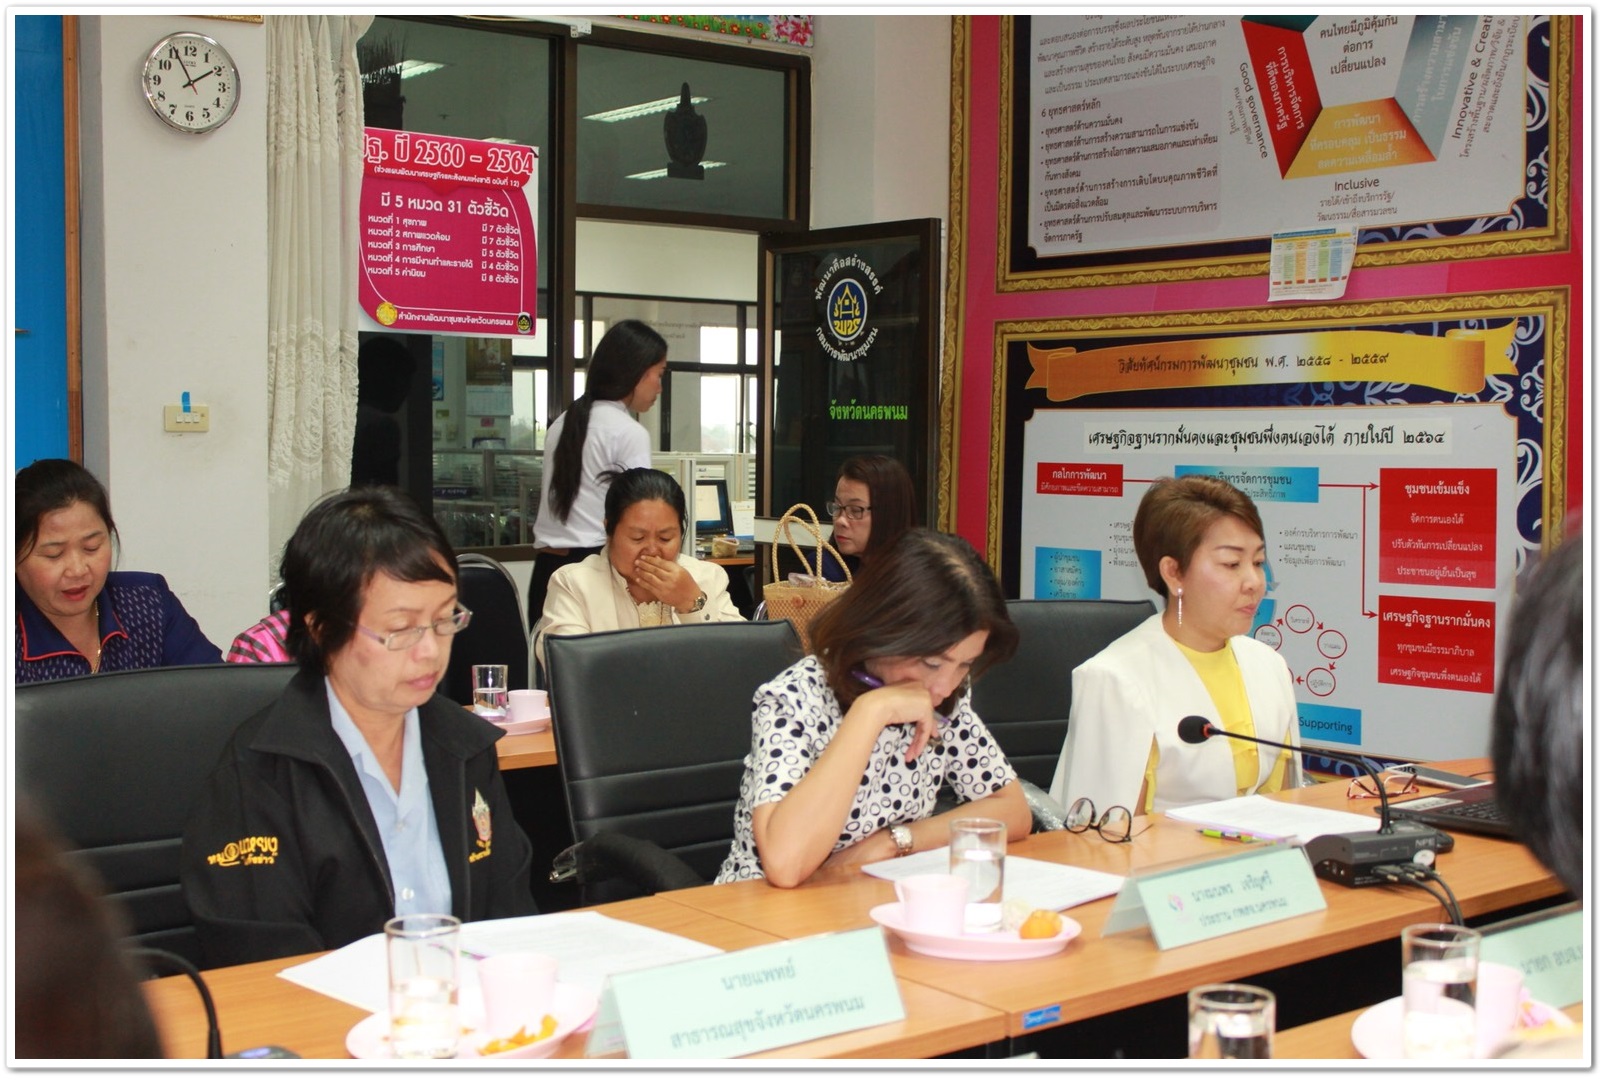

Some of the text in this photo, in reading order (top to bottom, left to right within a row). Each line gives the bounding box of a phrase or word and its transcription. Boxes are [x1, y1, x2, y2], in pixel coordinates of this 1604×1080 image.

[1320, 15, 1398, 39] คนไทยมีภูมิคุ้มกัน
[169, 46, 179, 59] 11
[184, 46, 197, 57] 12
[1343, 39, 1373, 54] ต่อการ
[204, 52, 209, 63] 1
[159, 59, 172, 71] 10
[214, 66, 222, 76] 2
[1330, 56, 1386, 75] เปลี่ยนแปลง
[153, 75, 161, 85] 9
[218, 82, 227, 93] 3
[1278, 46, 1305, 130] การบริหารจัดการ
[158, 91, 166, 101] 8
[213, 97, 220, 108] 4
[1266, 61, 1290, 131] ที่ดีของภาครัฐ
[1452, 72, 1478, 139] Innovative
[1471, 58, 1482, 68] &
[169, 104, 177, 115] 7
[186, 111, 194, 122] 6
[202, 108, 211, 118] 5
[1041, 109, 1047, 118] 6
[1240, 62, 1268, 159] Good governance
[1335, 115, 1381, 128] การพัฒนา
[394, 134, 410, 163] ปี
[414, 139, 465, 168] 2560
[487, 148, 534, 176] 2564
[1334, 178, 1380, 192] Inclusive
[381, 192, 509, 218] มี 5 หมวด 31 ตัวชี้วัด
[368, 213, 427, 228] หมวดที่ 1 สุขภาพ
[368, 226, 393, 237] หมวดที่
[402, 230, 451, 242] สภาพแวดล้อม
[482, 223, 488, 232] มี
[496, 222, 520, 235] ตัวชี้วัด
[368, 238, 435, 253] หมวดที่ 3 การศึกษา
[482, 236, 488, 245] มี
[496, 236, 519, 248] ตัวชี้วัด
[368, 251, 393, 263] หมวดที่
[402, 256, 473, 269] การมีงานทำและรายได้
[482, 248, 488, 257] มี
[496, 248, 519, 260] ตัวชี้วัด
[368, 264, 393, 275] หมวดที่
[402, 266, 426, 278] ค่านิยม
[482, 260, 488, 270] มี
[496, 260, 519, 272] ตัวชี้วัด
[482, 273, 487, 282] มี
[496, 272, 519, 284] ตัวชี้วัด
[815, 254, 884, 300] พัฒนาคือสร้างสรรค์
[398, 312, 514, 326] สำนักงานพัฒนาชุมชนจังหวัดนครพนม
[816, 326, 879, 362] กรมการพัฒนาชุมชน
[1118, 354, 1258, 376] วิสัยทัศน์กรมการพัฒนาชุมชน
[1265, 354, 1289, 369] พ.ศ.
[829, 399, 908, 420] จังหวัดนครพนม
[1089, 422, 1446, 453] เศรษฐกิจฐานรากมั่นคงและชุมชนพึ่งตนเองได้ ภายในปี ๒๕๖๔
[1052, 467, 1107, 481] กลไกการพัฒนา
[1405, 480, 1470, 498] ชุมชนเข้มแข็ง
[1411, 512, 1464, 524] จัดการตนเองได้
[1392, 538, 1483, 551] ปรับตัวทันการเปลี่ยนแปลง
[1397, 566, 1477, 581] ประชาชนอยู่เย็นเป็นสุข
[1383, 610, 1491, 629] เศรษฐกิจฐานรากมั่นคง
[1397, 642, 1475, 657] ทุกชุมชนมีธรรมาภิบาล
[1390, 667, 1482, 684] เศรษฐกิจชุมชนพึ่งตนเองได้
[1298, 717, 1352, 736] Supporting
[1415, 838, 1435, 848] NPE
[721, 957, 796, 991] นายแพทย์
[670, 995, 865, 1049] สาธารณสุขจังหวัดนครพนม
